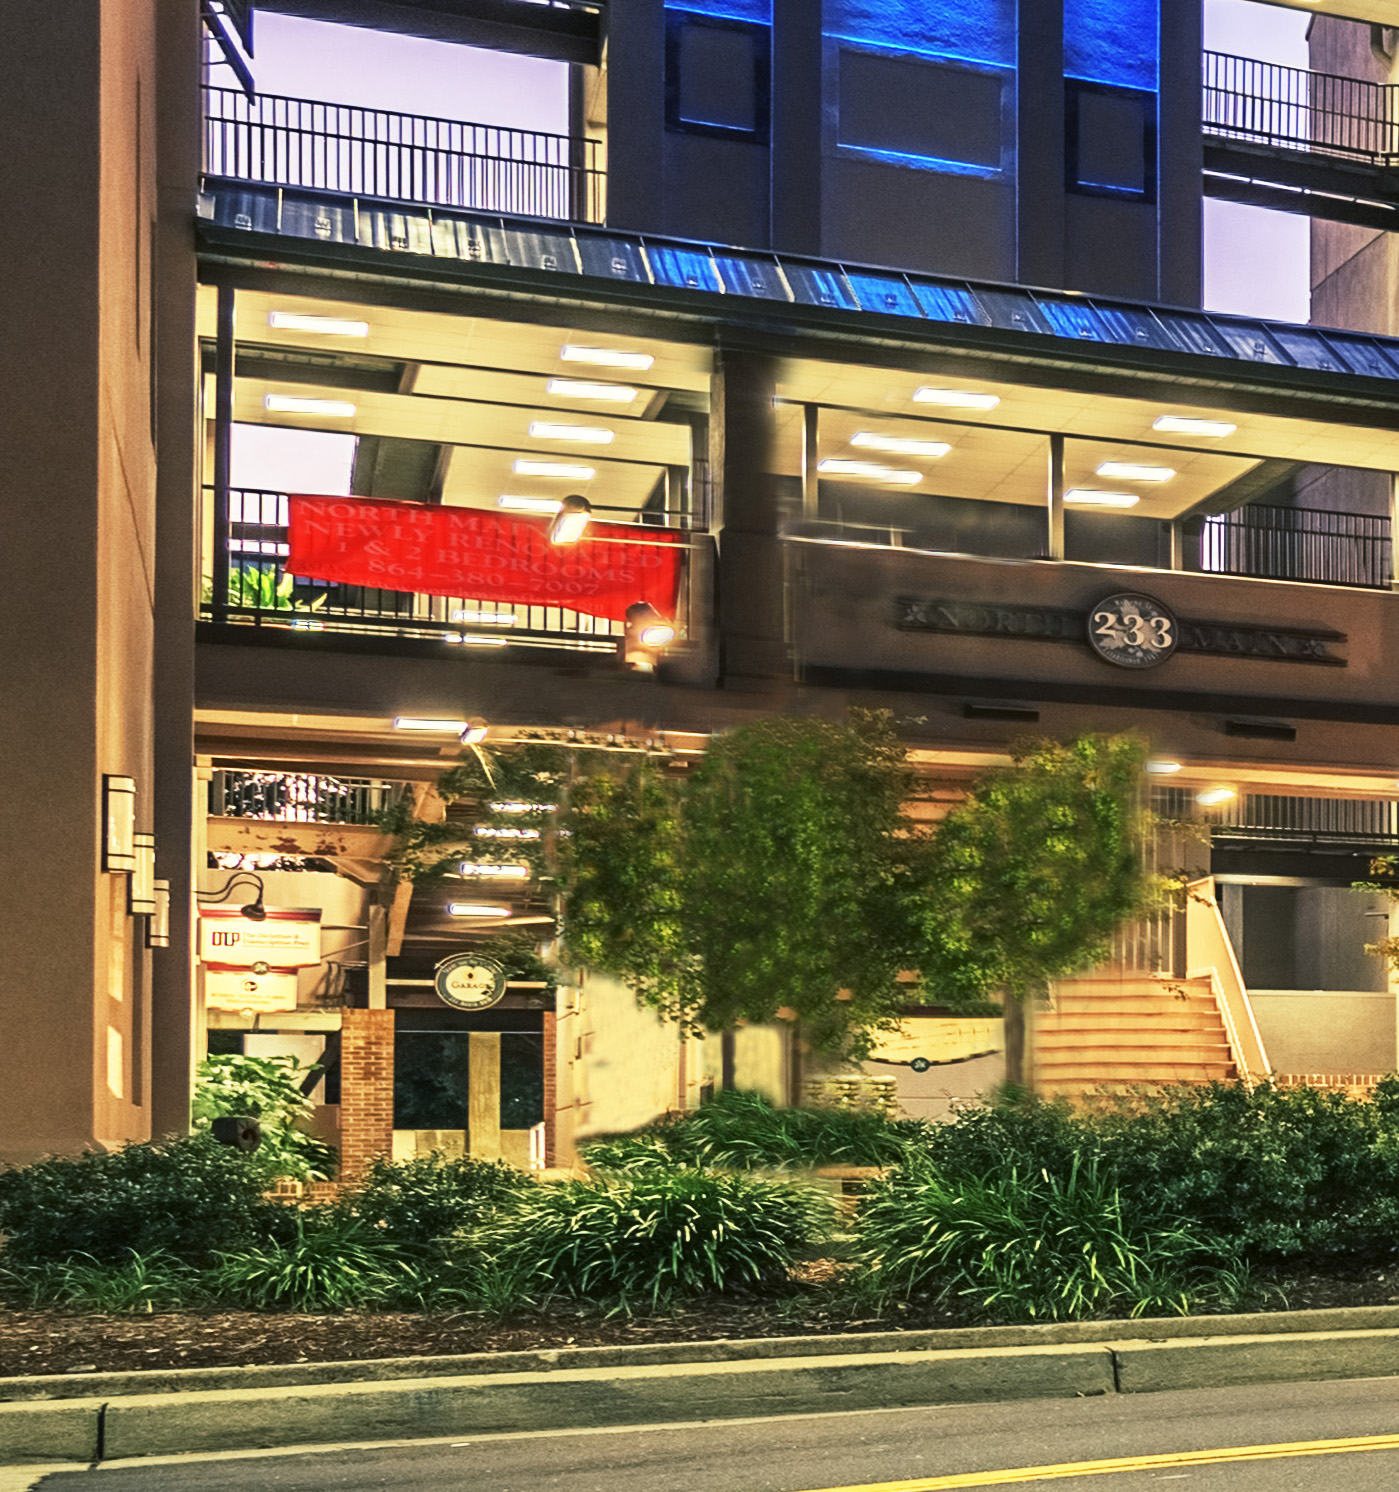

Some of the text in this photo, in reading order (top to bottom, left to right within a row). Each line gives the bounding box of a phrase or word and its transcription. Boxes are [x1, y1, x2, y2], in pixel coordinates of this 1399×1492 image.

[298, 501, 435, 525] NORTH
[304, 520, 434, 543] NEWLY
[449, 532, 664, 568] RENOVATED
[338, 540, 636, 583] 1 & 2 BEDROOMS
[1094, 611, 1172, 649] 233
